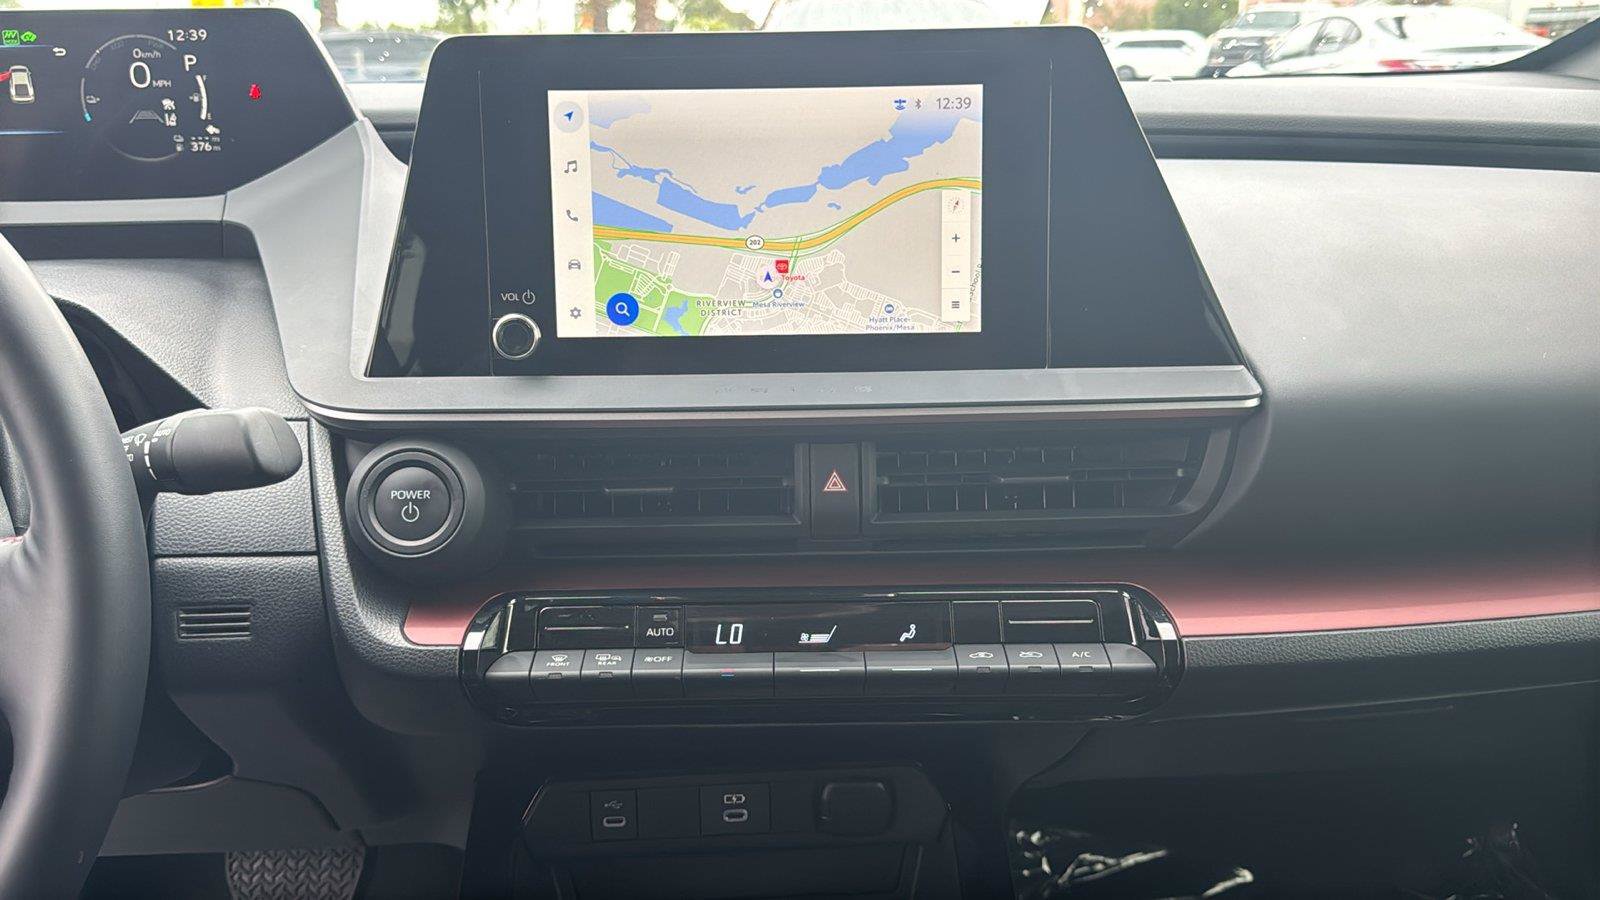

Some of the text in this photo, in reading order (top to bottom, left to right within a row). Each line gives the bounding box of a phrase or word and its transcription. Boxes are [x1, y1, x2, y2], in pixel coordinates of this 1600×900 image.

[167, 29, 208, 41] 12:39
[183, 54, 197, 72] P
[129, 61, 172, 89] 0 MPH
[936, 97, 972, 110] 12:39
[190, 141, 213, 152] 376
[781, 274, 806, 282] Toyota
[500, 292, 520, 302] VOL
[696, 300, 746, 308] RIVERVIEW
[752, 301, 805, 309] Mesa Riverview
[700, 309, 742, 317] DISTRICT
[868, 316, 889, 324] Hyatt
[390, 490, 431, 500] POWER
[646, 627, 675, 638] AUTO
[653, 655, 673, 663] OFF
[1072, 651, 1092, 659] A/C
